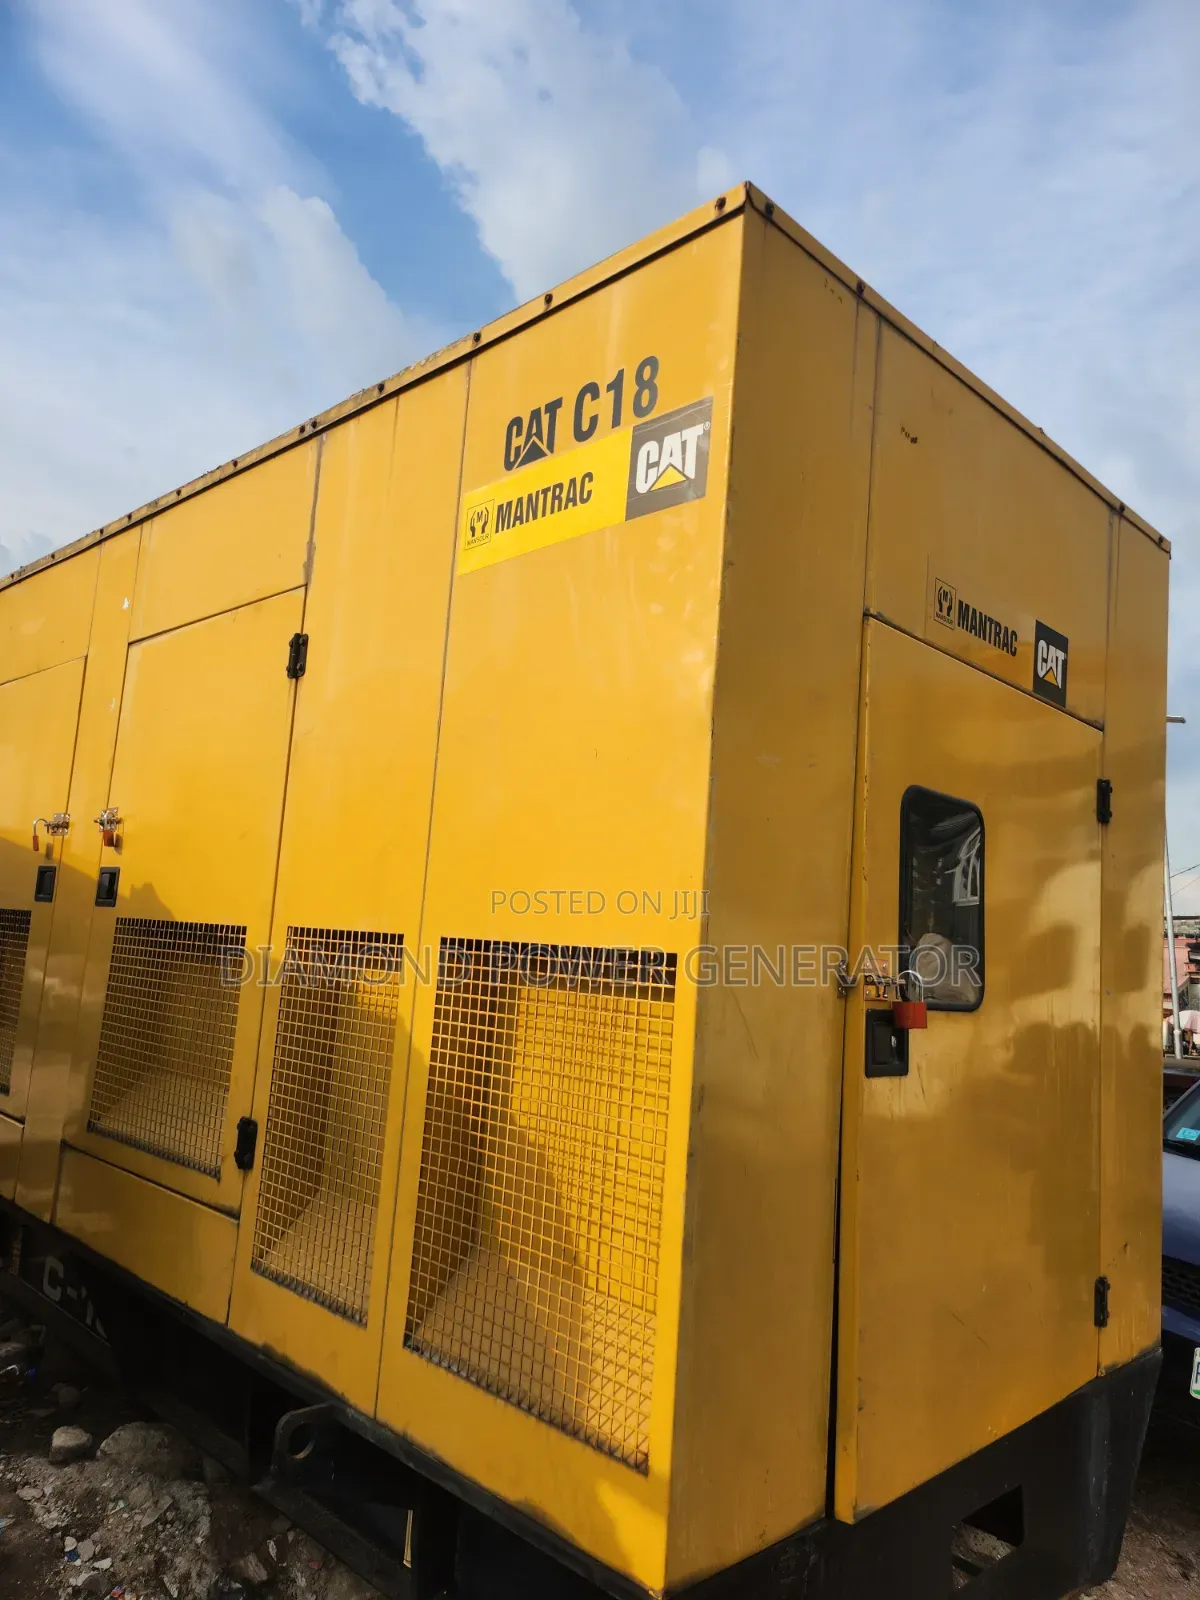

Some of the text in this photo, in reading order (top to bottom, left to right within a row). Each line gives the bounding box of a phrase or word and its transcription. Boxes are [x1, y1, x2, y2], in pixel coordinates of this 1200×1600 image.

[503, 355, 660, 472] CAT C18
[494, 471, 594, 534] MANTRAC
[957, 599, 1018, 657] MANTRAC
[1037, 639, 1065, 689] CAT
